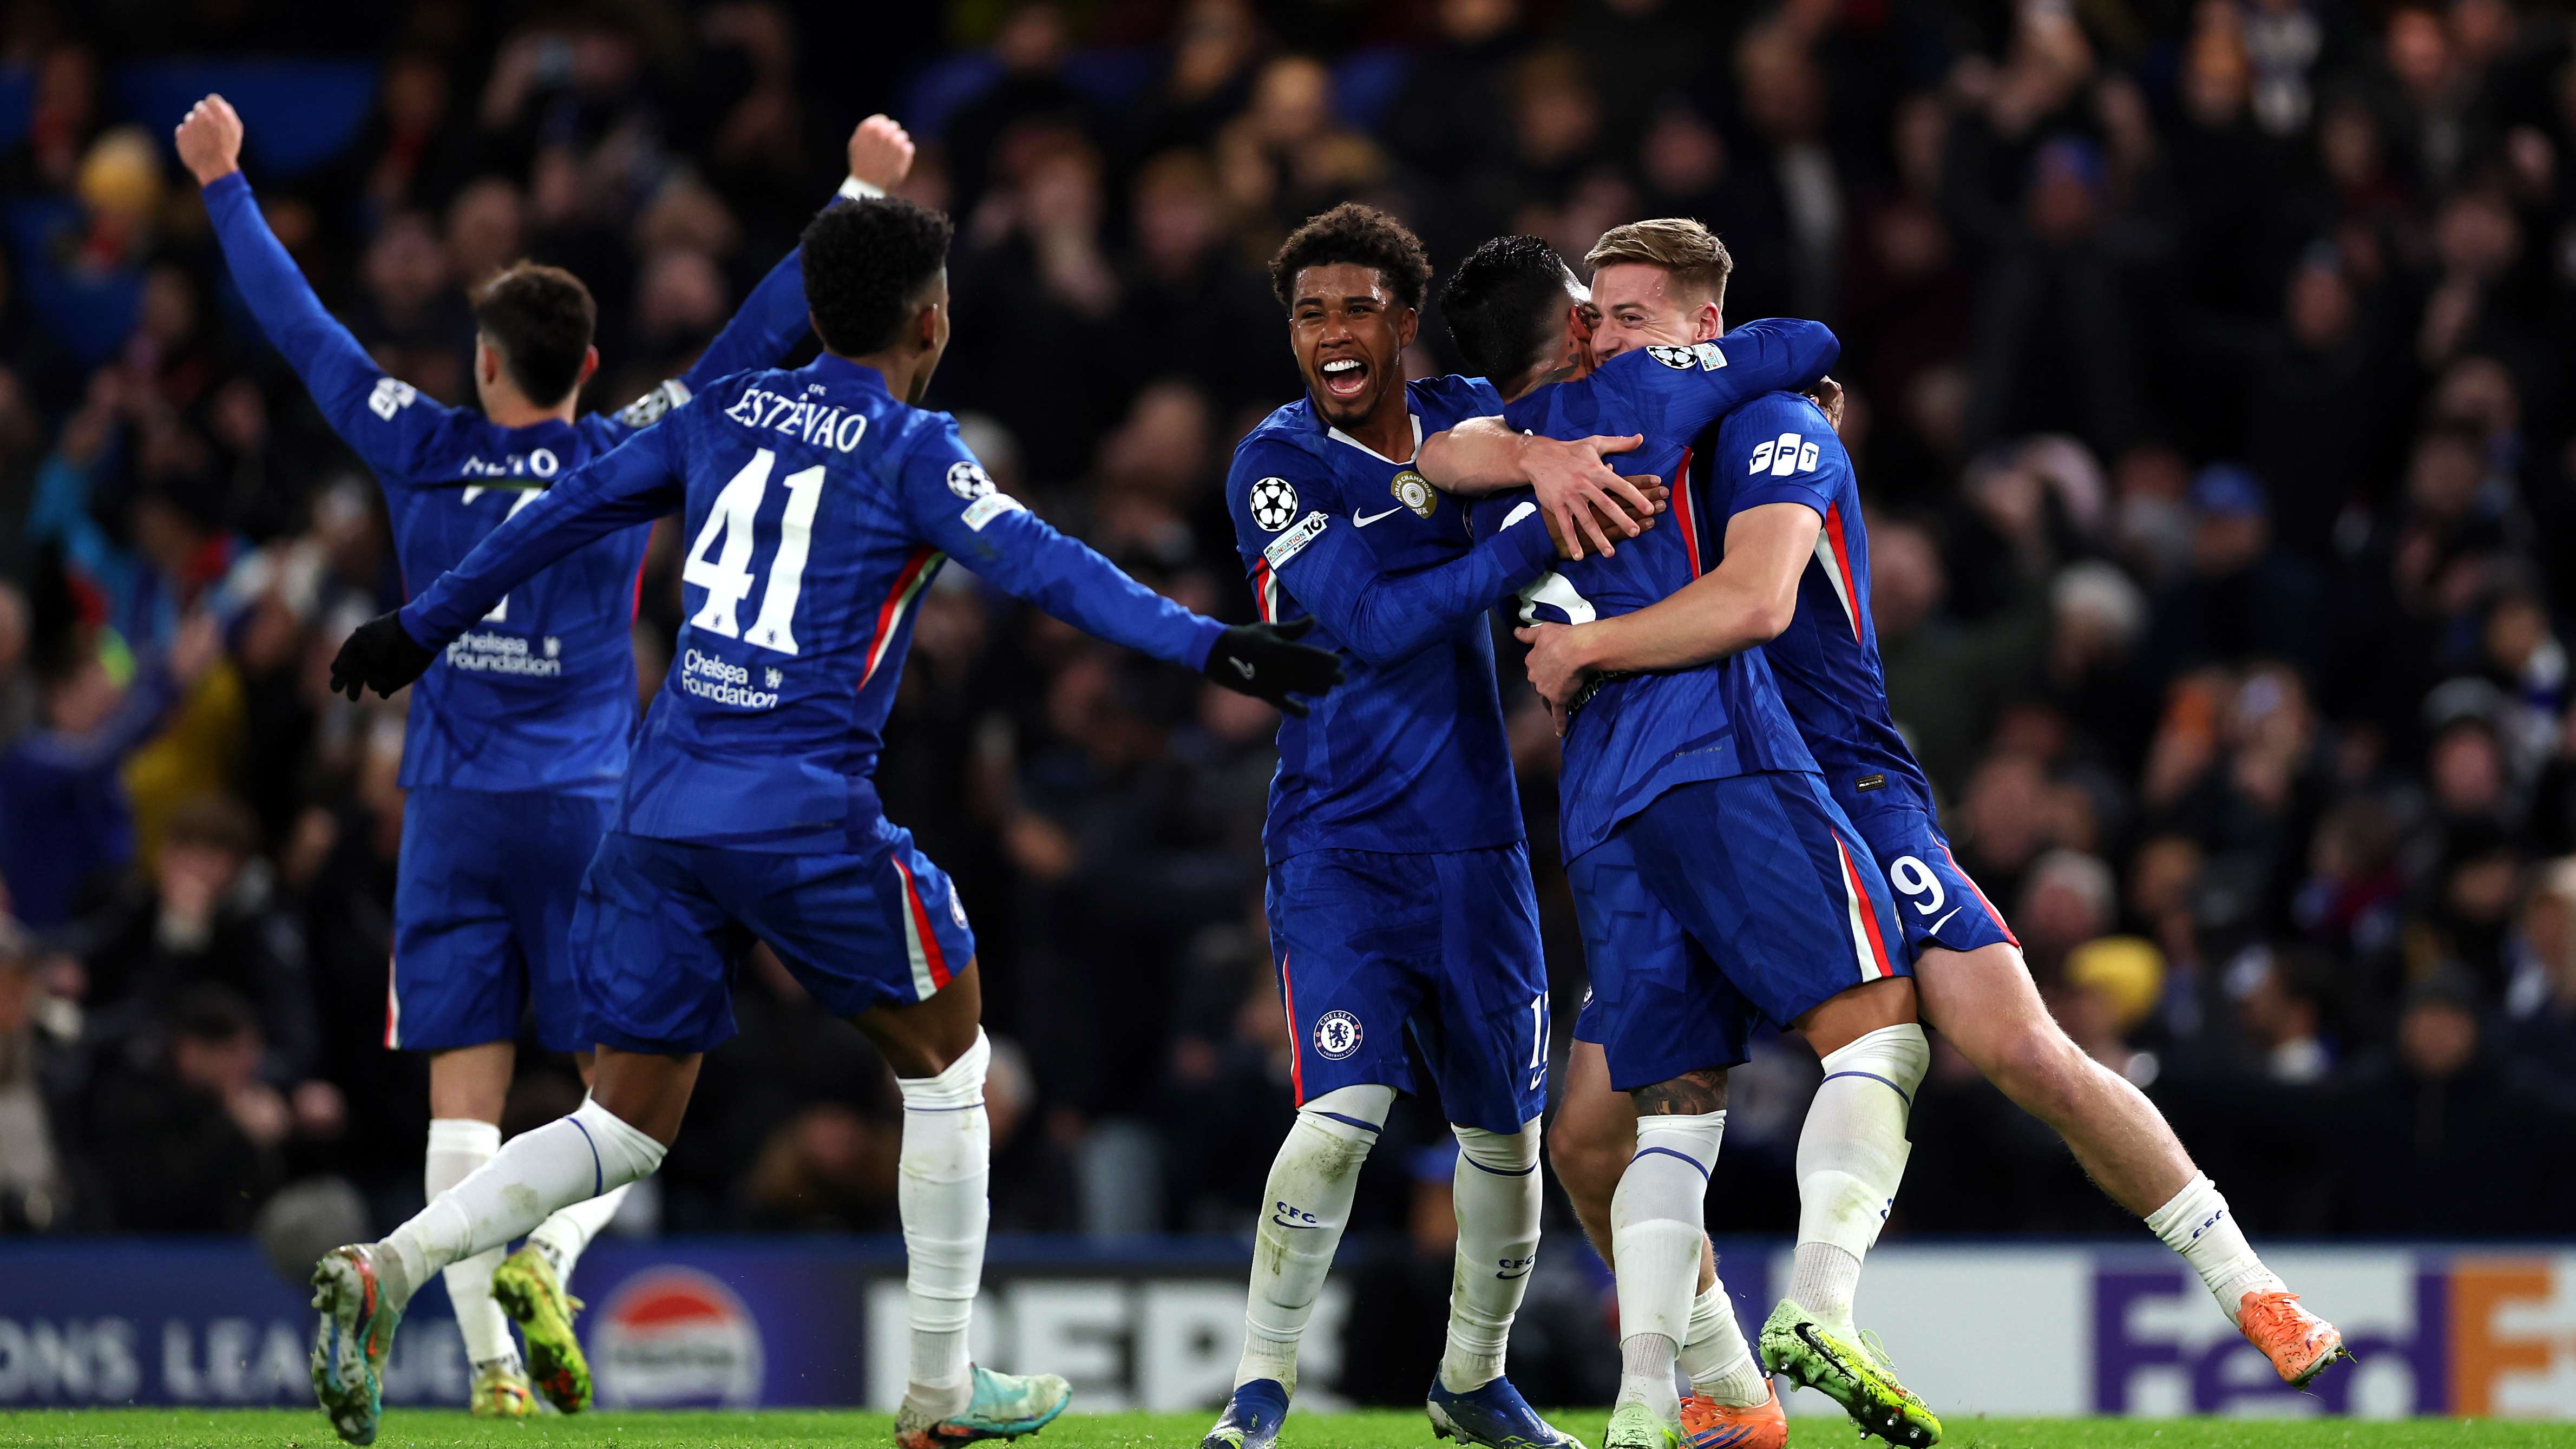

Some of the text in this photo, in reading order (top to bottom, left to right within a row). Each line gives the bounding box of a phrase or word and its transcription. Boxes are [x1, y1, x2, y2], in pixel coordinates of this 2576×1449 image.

[724, 388, 867, 453] ESTÊVÃO
[1749, 432, 1819, 476] FPT
[1401, 474, 1433, 498] CHAMPIONS
[682, 447, 827, 656] 41
[1268, 532, 1306, 562] FOUNDATION
[684, 648, 749, 686] Chelsea
[681, 669, 779, 709] Foundation
[1890, 855, 1945, 916] 9
[1320, 1012, 1352, 1026] CHELSEA
[1276, 1201, 1317, 1224] CFC
[1498, 1255, 1534, 1269] CFC
[2093, 1260, 2576, 1414] FedE
